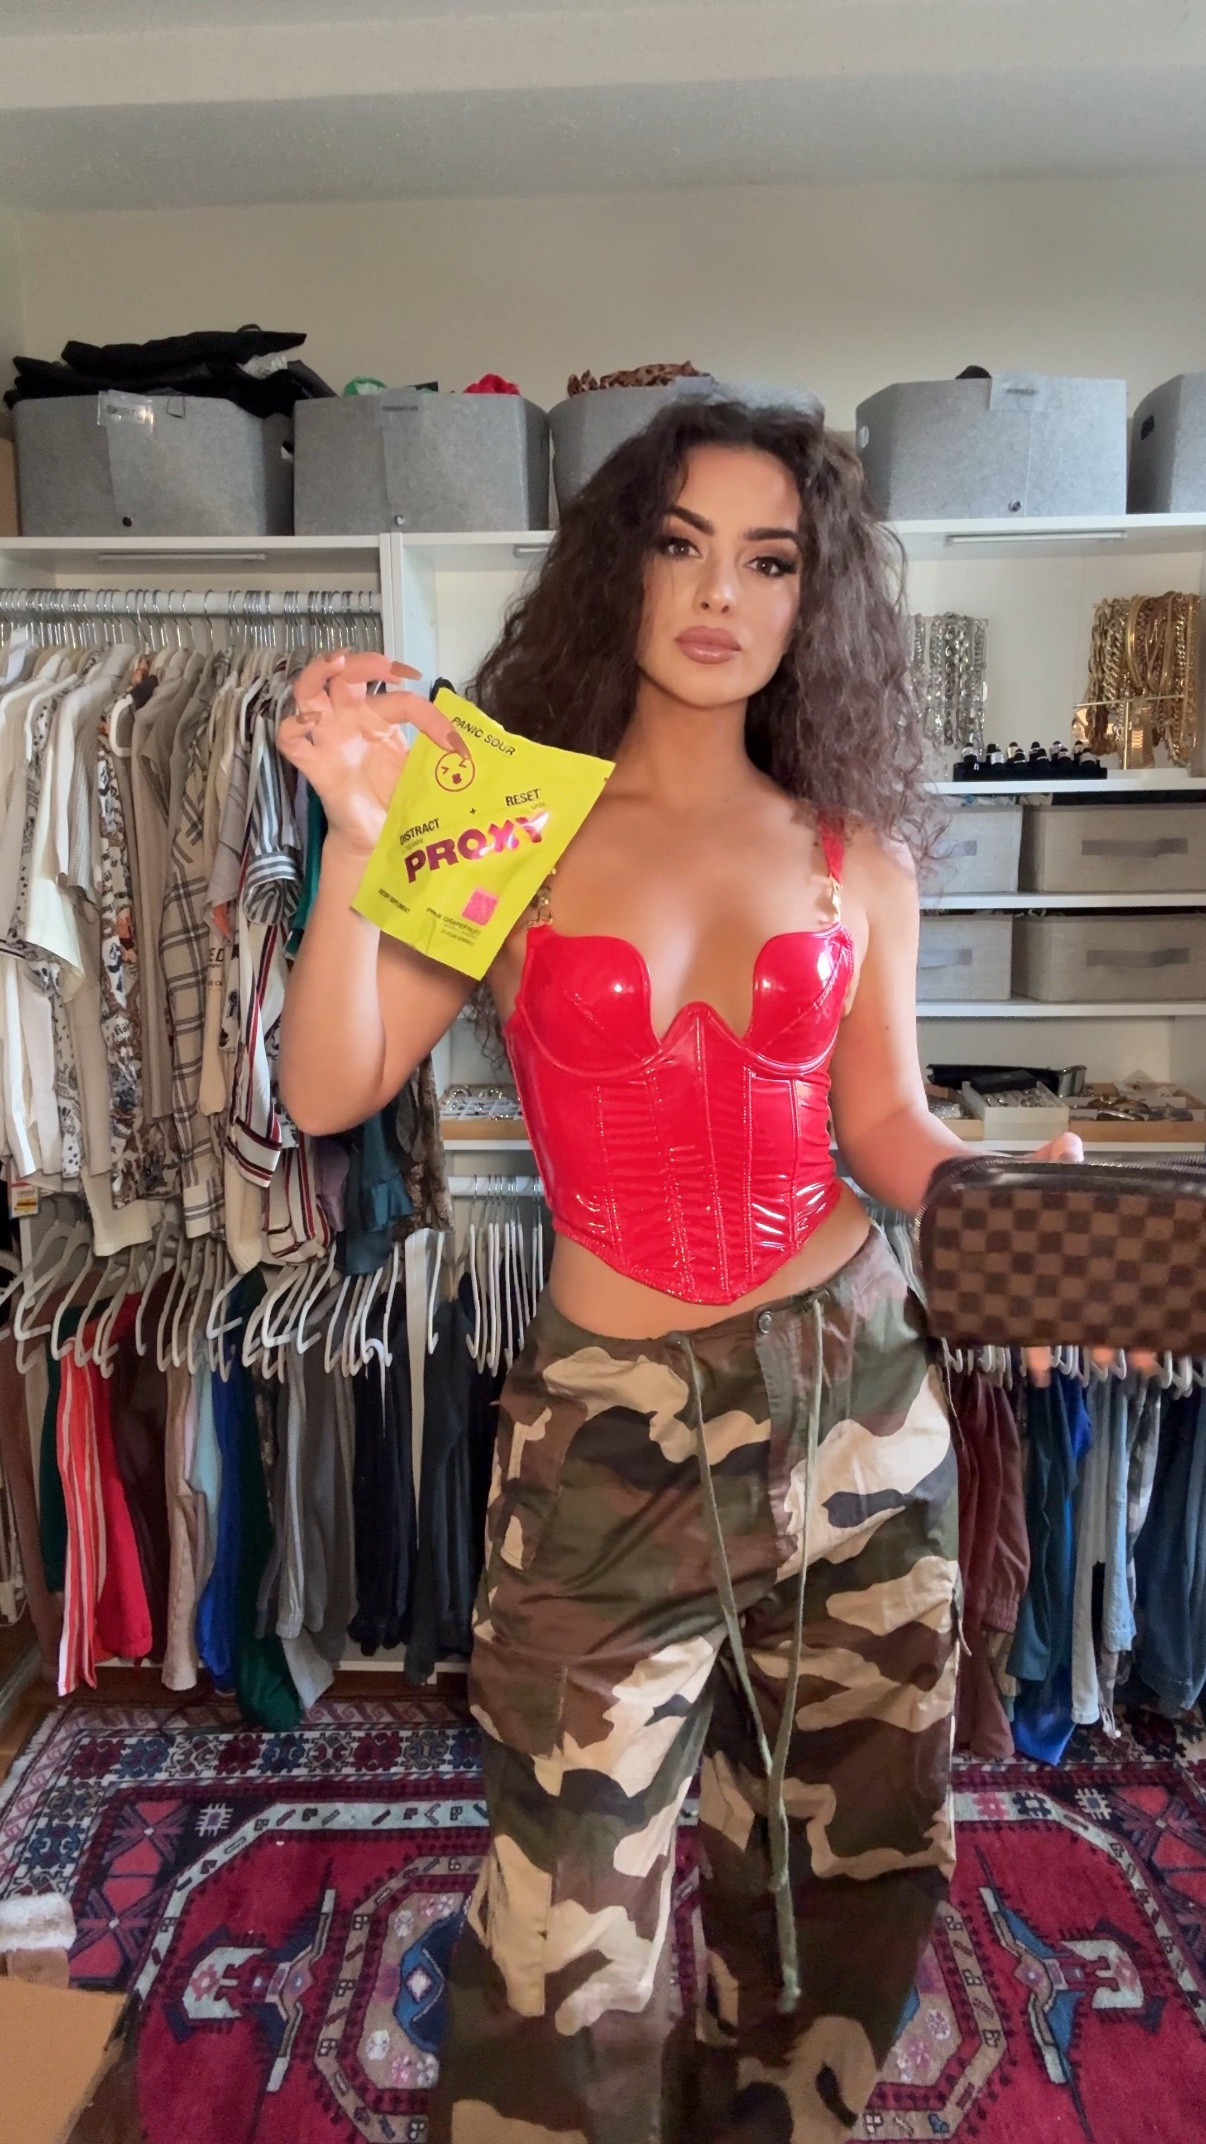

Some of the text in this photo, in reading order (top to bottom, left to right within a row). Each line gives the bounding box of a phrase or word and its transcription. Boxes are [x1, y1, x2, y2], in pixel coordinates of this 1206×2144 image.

[452, 716, 516, 756] PANIC SOUR
[400, 818, 440, 846] DISTRACT
[506, 788, 541, 807] RESET
[404, 811, 550, 884] PROXY
